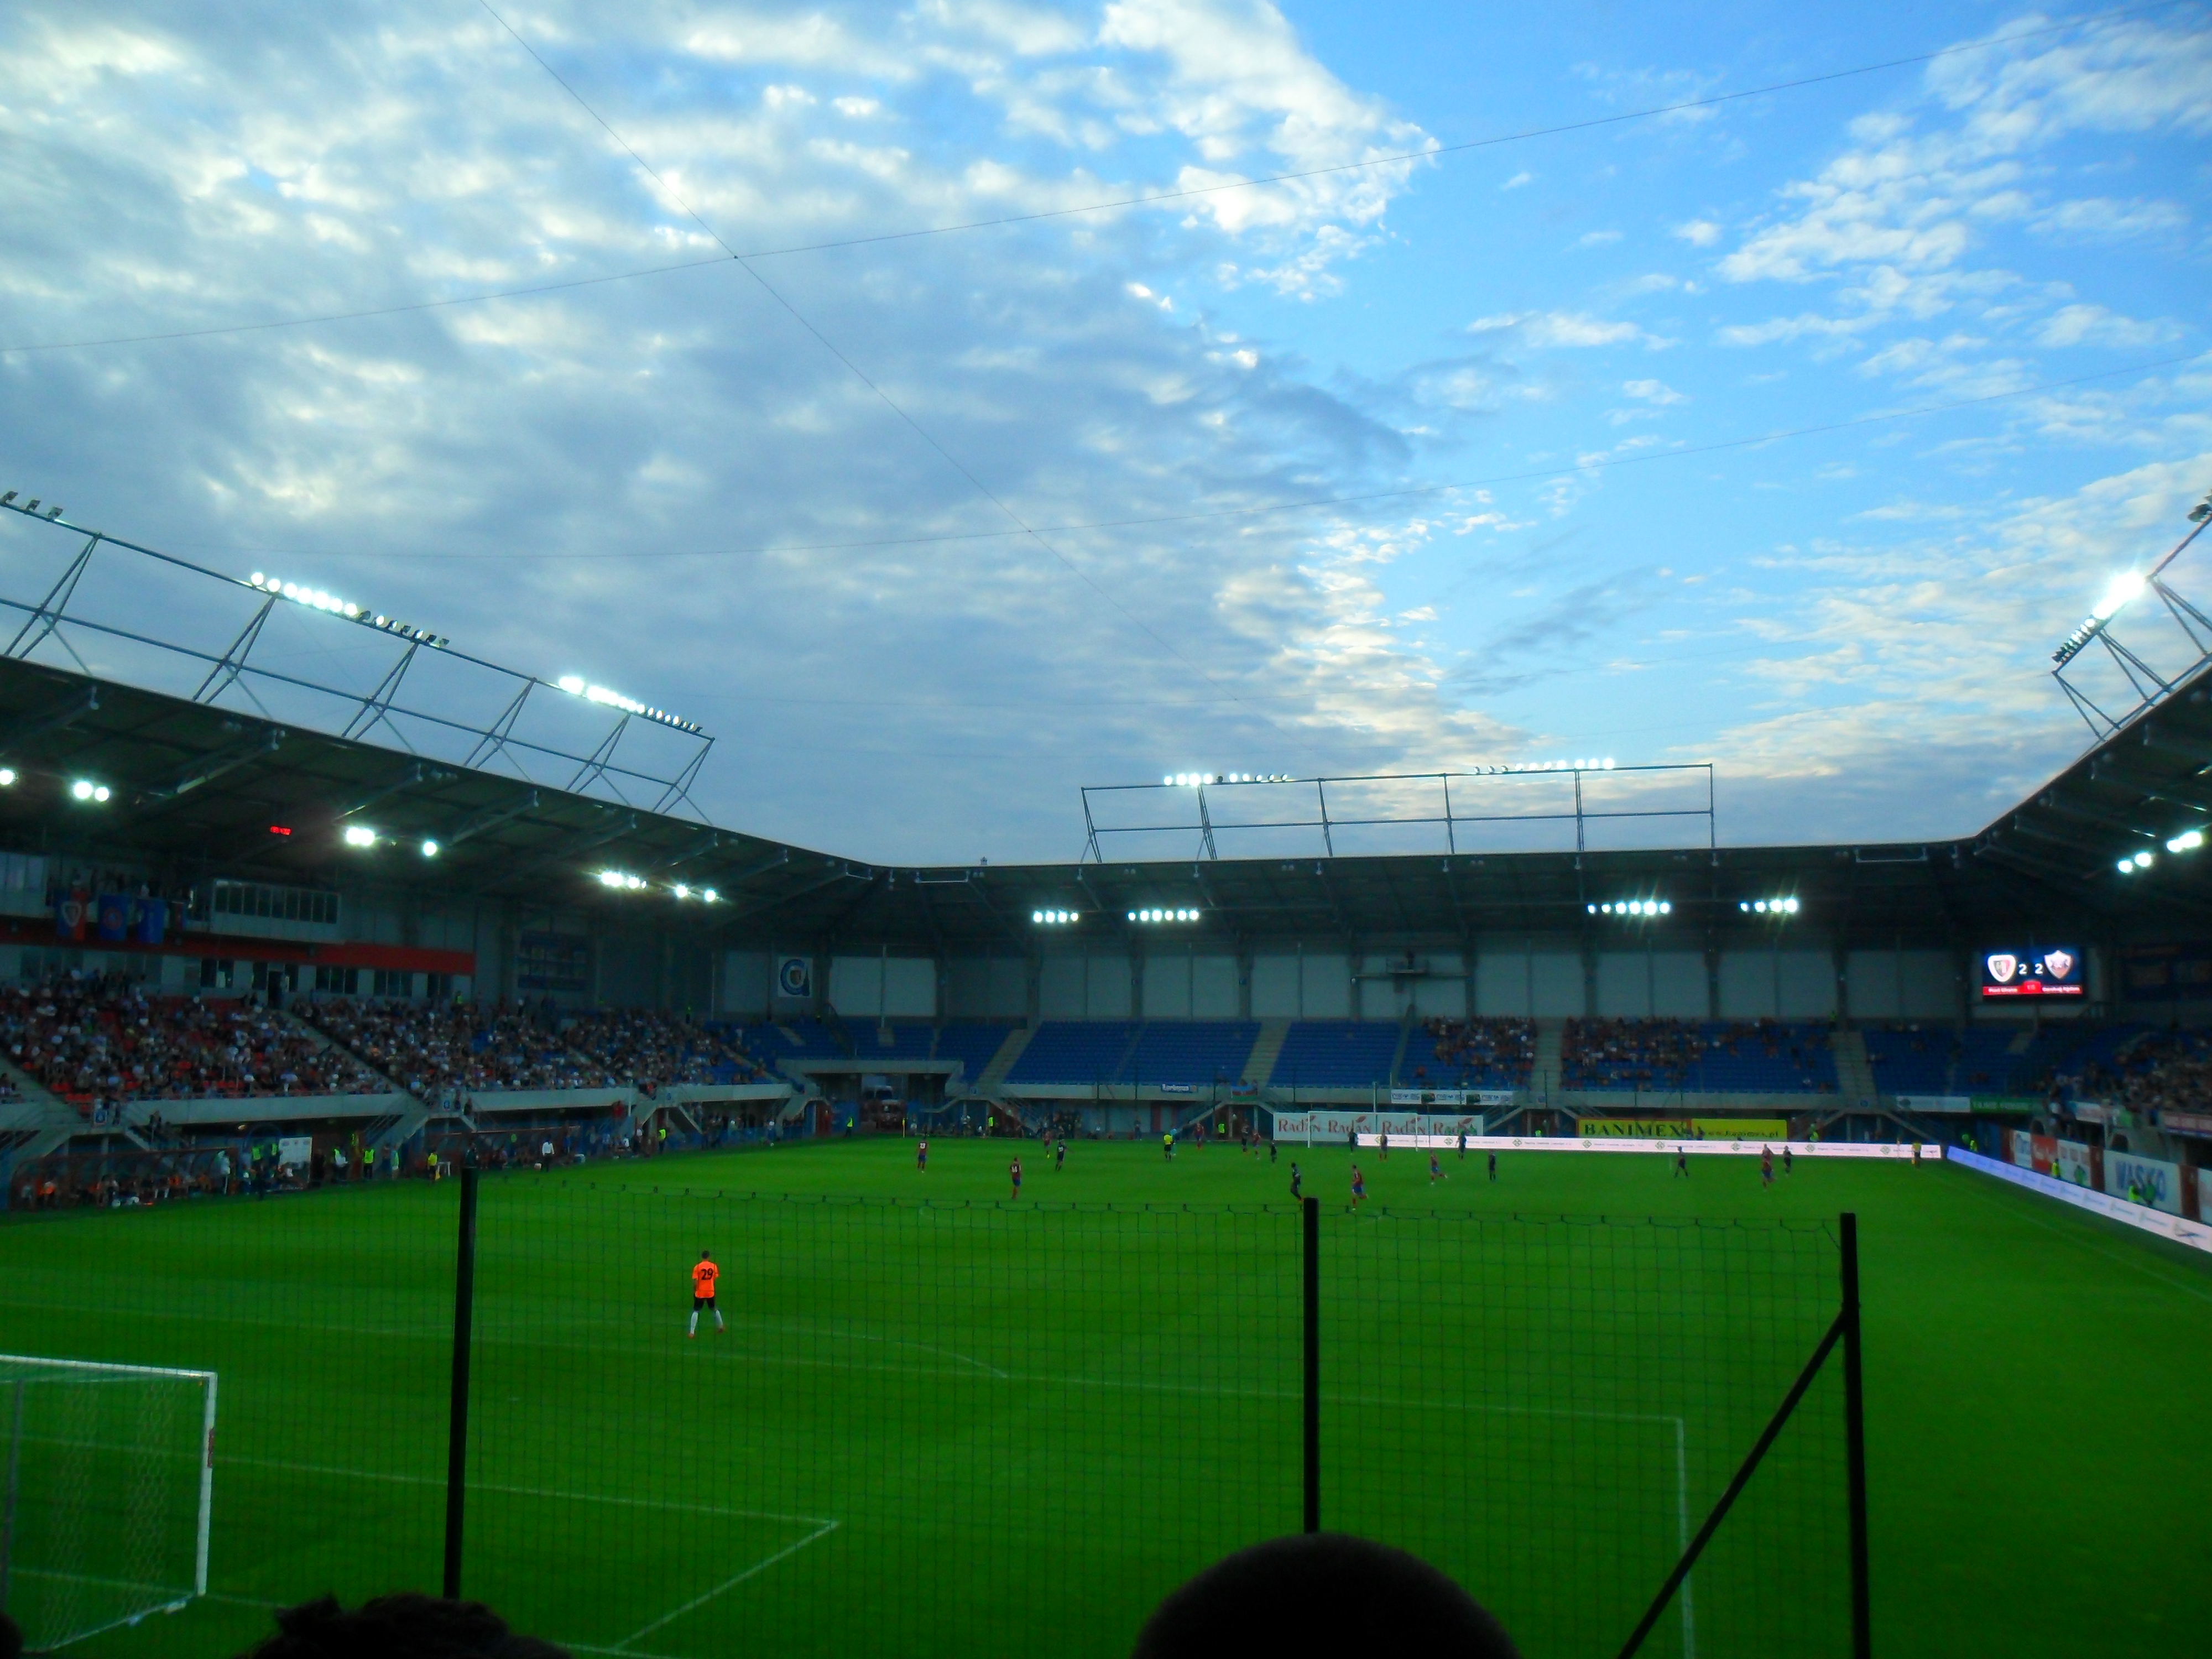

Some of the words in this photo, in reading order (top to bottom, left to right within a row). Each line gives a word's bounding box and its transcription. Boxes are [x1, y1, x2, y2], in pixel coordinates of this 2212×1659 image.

[2018, 963, 2027, 974] 2
[2034, 963, 2043, 974] 2
[1584, 1123, 1686, 1138] BANIMEX
[701, 1267, 713, 1280] 29
